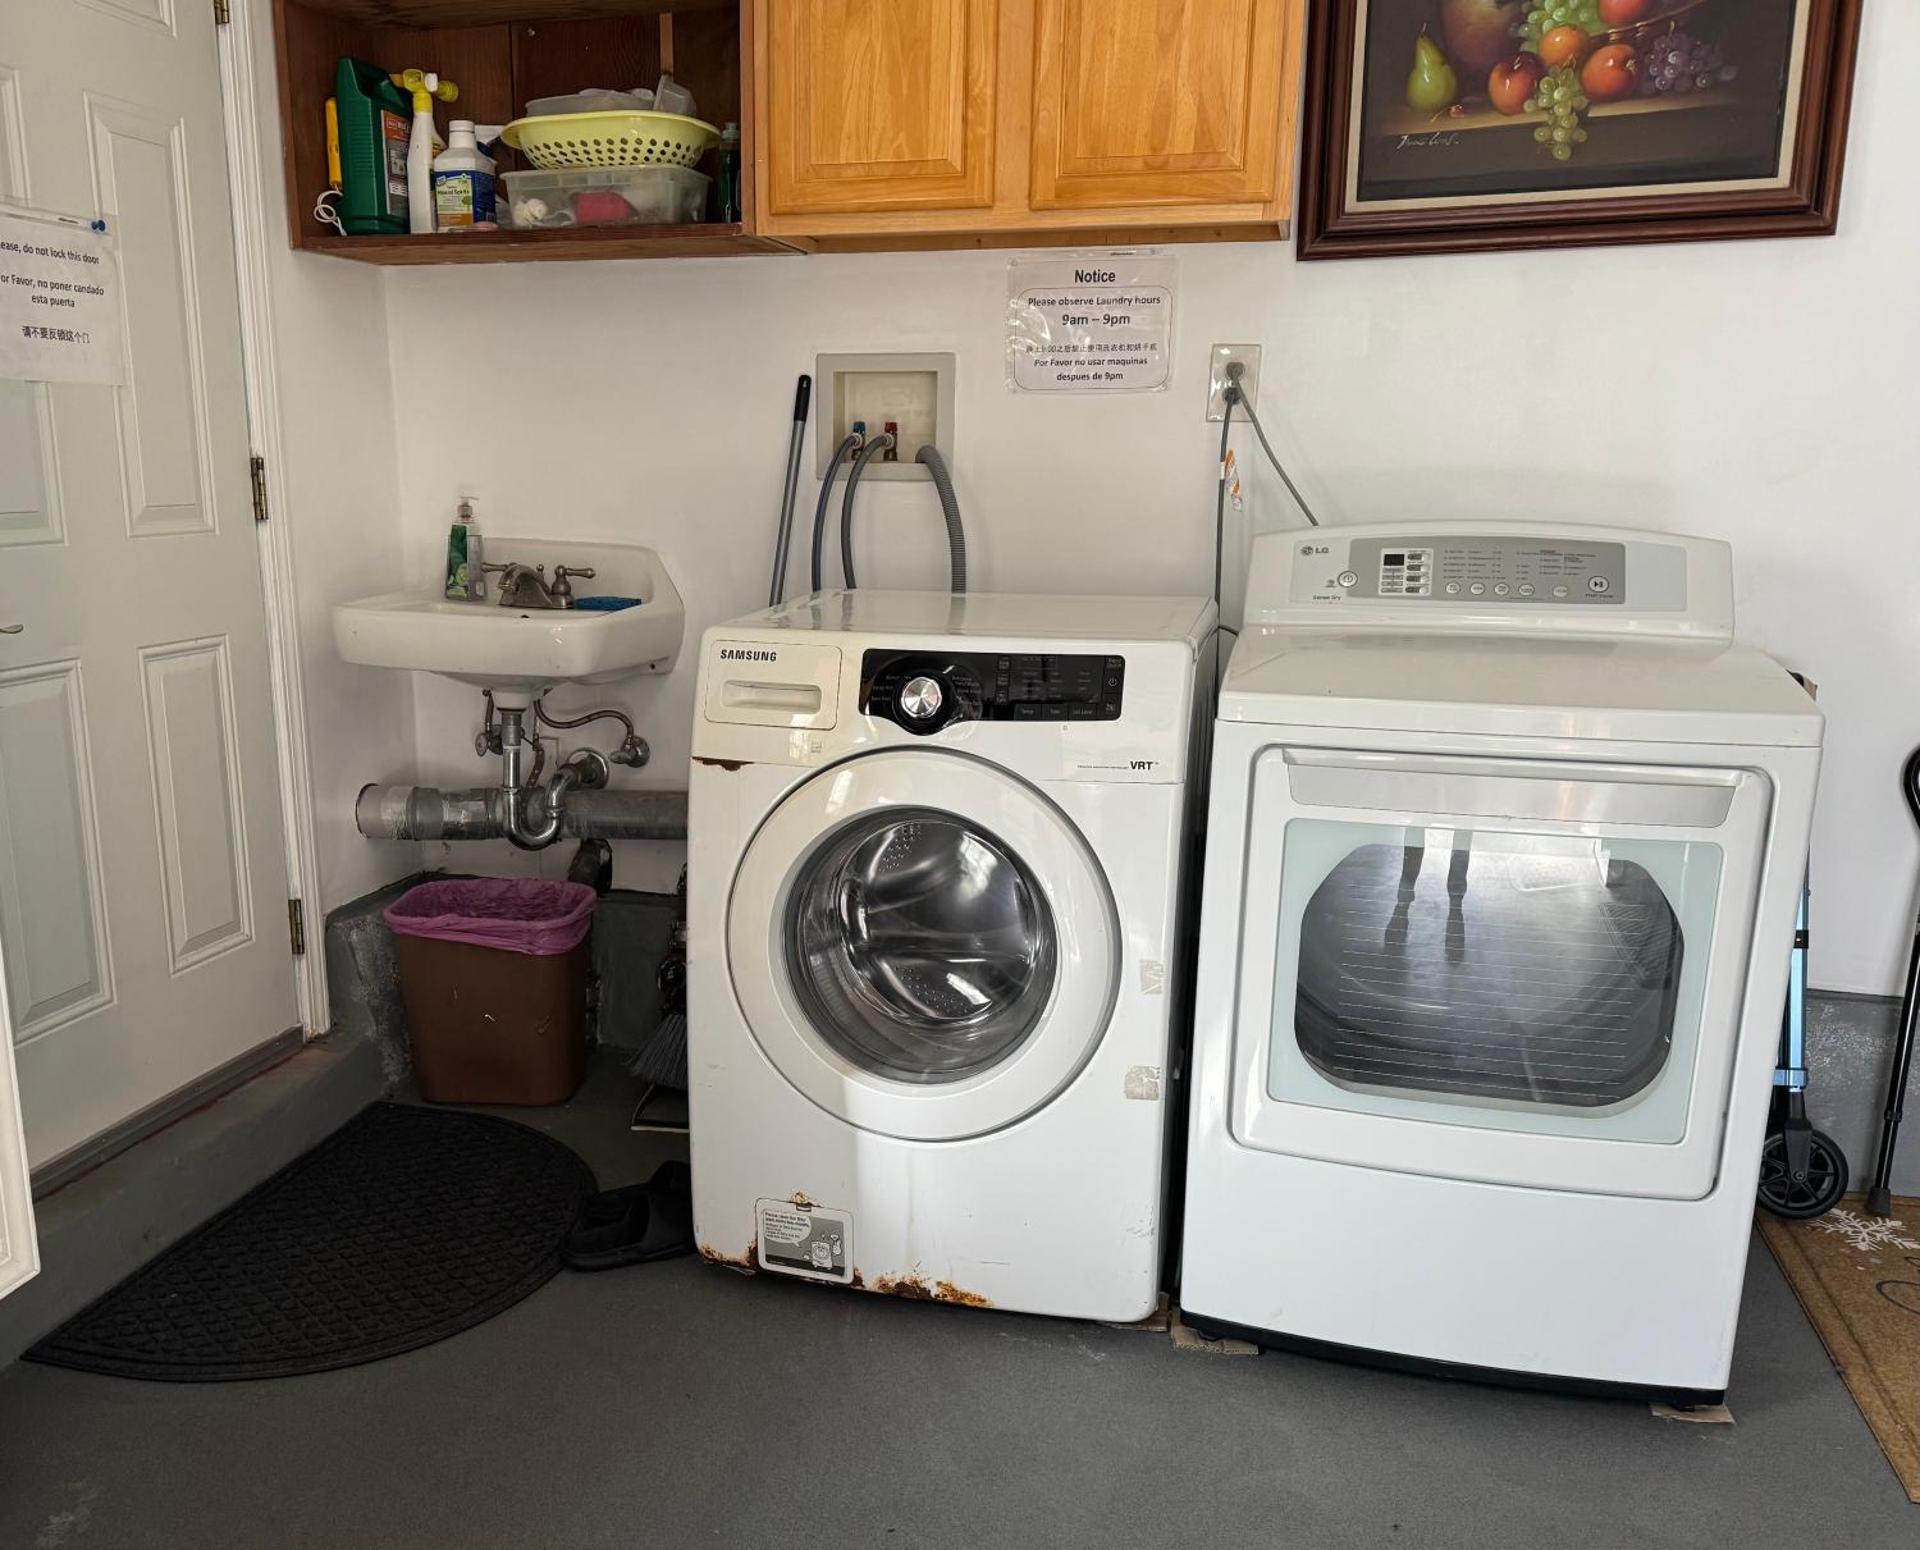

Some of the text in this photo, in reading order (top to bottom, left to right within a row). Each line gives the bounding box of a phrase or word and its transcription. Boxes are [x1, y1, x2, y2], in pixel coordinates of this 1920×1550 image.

[0, 241, 100, 264] ease, do not lock this door
[1075, 269, 1116, 283] Notice
[0, 274, 104, 296] or Favor, no poner candado
[32, 295, 75, 308] esta puerta
[1028, 296, 1161, 307] Please observe Laundry hours
[1062, 314, 1089, 326] 9am
[1103, 313, 1131, 327] 9pm
[1050, 359, 1073, 367] Favor
[1107, 358, 1148, 368] maquinas
[1057, 371, 1123, 382] despues de 9pm
[721, 649, 777, 661] SAMSUNG
[1130, 761, 1154, 770] VRT
